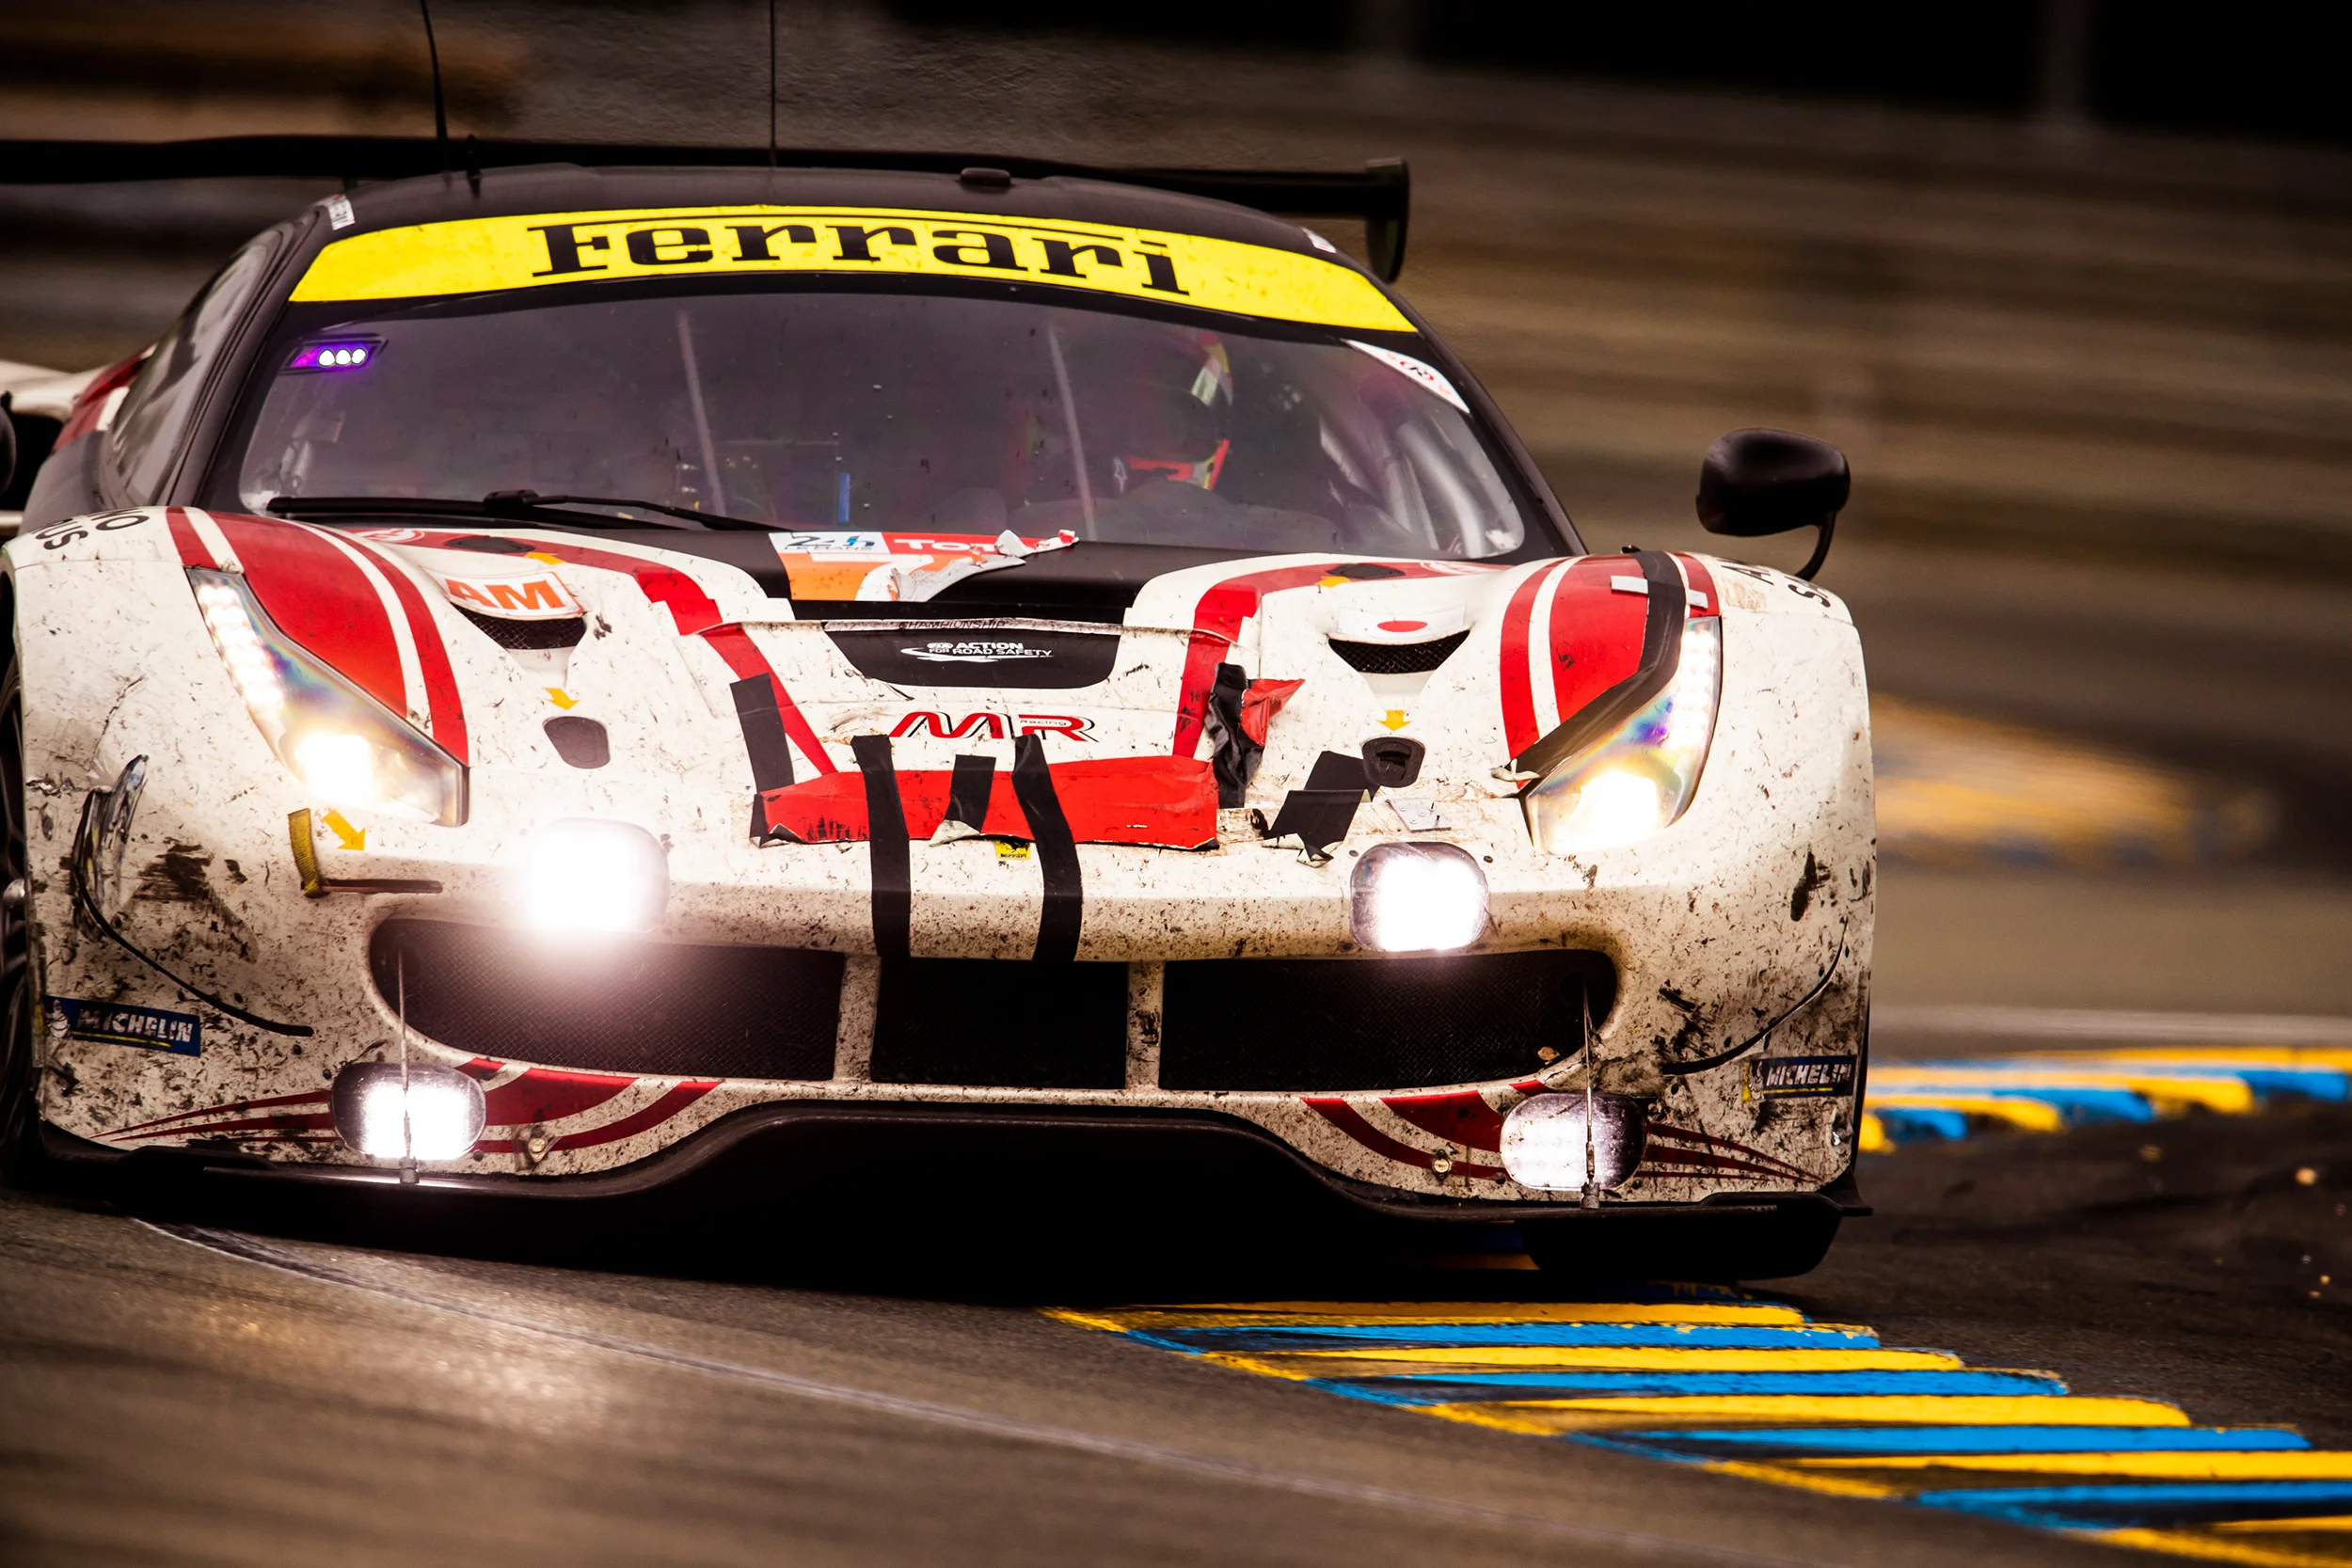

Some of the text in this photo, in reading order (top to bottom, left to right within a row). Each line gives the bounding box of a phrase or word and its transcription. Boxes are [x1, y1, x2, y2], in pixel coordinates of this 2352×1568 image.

[526, 214, 1190, 296] Ferrari
[444, 578, 566, 610] AM
[898, 618, 1007, 630] CHAMPIONSHIP
[995, 648, 1052, 657] SAFETY
[76, 1008, 194, 1043] MICHELIN
[1765, 1063, 1852, 1086] MICHELIN
